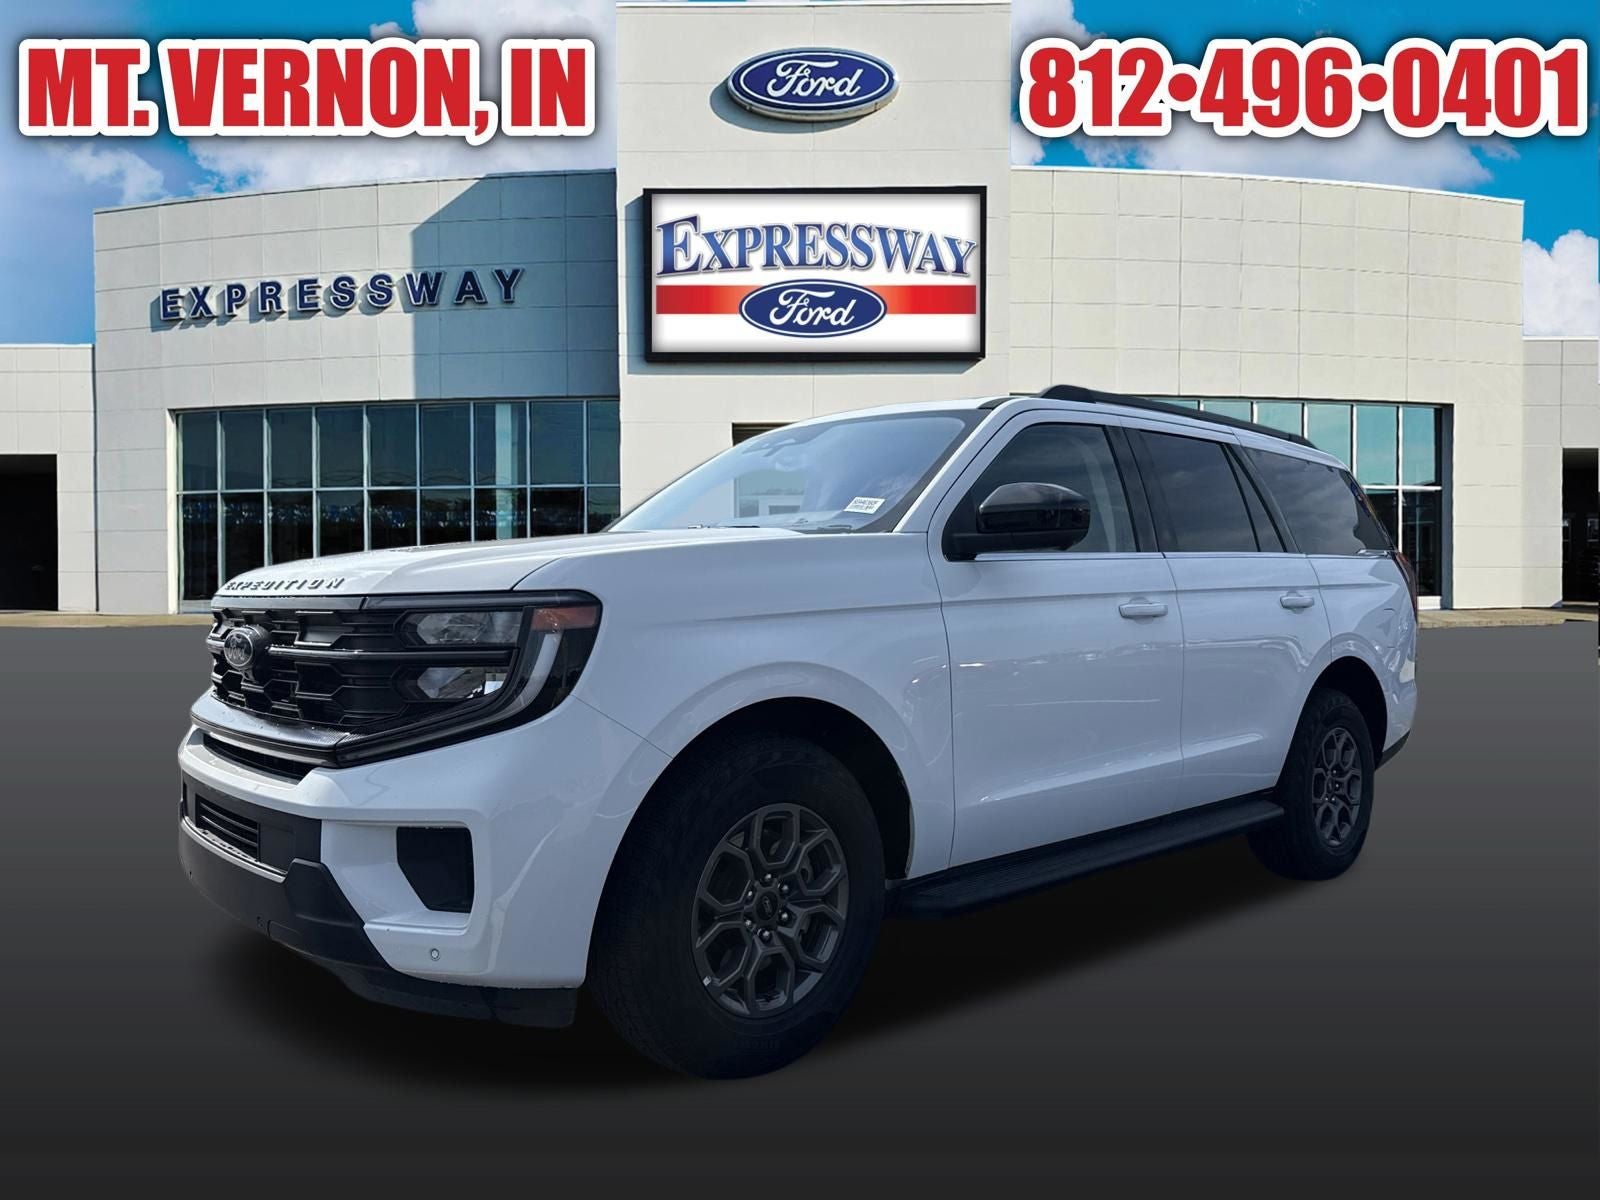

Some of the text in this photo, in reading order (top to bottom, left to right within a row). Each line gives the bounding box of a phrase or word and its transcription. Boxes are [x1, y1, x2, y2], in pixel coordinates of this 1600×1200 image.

[766, 59, 864, 98] Ford
[655, 213, 978, 278] EXPRESSWAY
[159, 267, 525, 323] EXPRESSWAY
[768, 288, 858, 327] Ford
[224, 577, 346, 591] EXPEDITION
